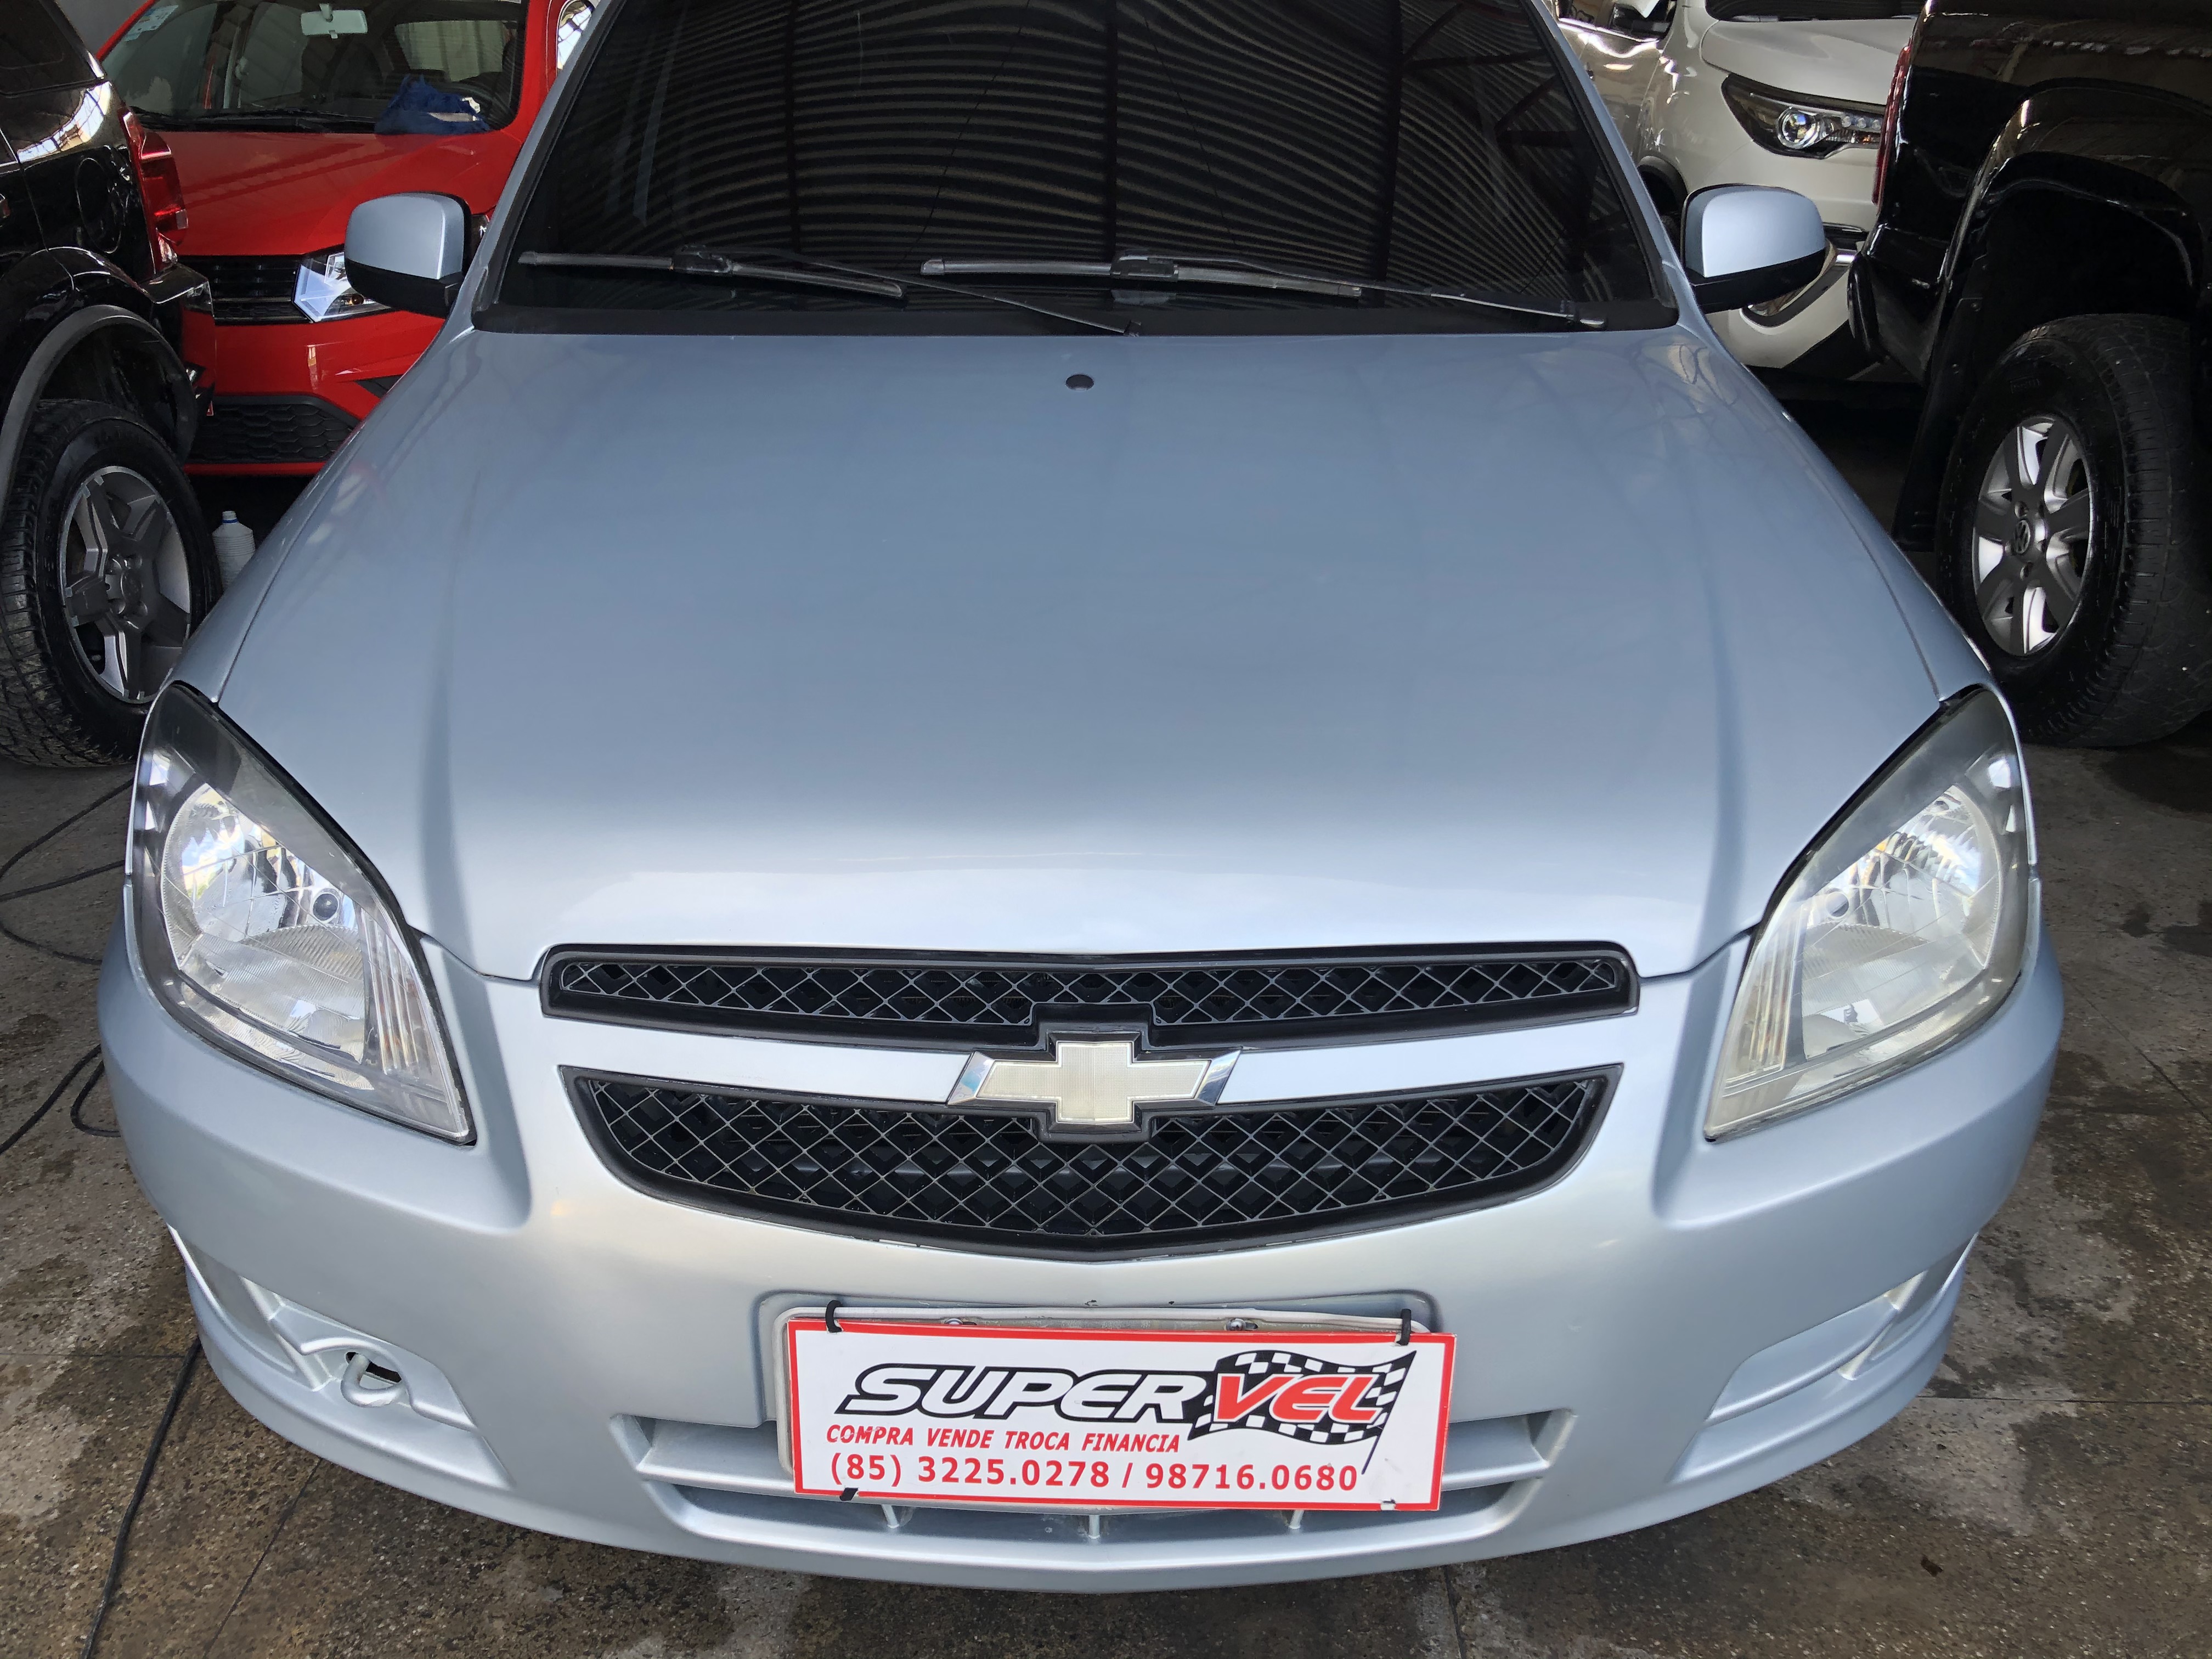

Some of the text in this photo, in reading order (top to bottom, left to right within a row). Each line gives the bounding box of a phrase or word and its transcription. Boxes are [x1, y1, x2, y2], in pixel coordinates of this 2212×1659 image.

[826, 1424, 1180, 1453] COMPRA VENDE TROCA FINANCIA
[831, 1452, 901, 1487] (85)
[918, 1455, 1110, 1488] 3225.0278
[1145, 1462, 1358, 1492] 98716.0680
